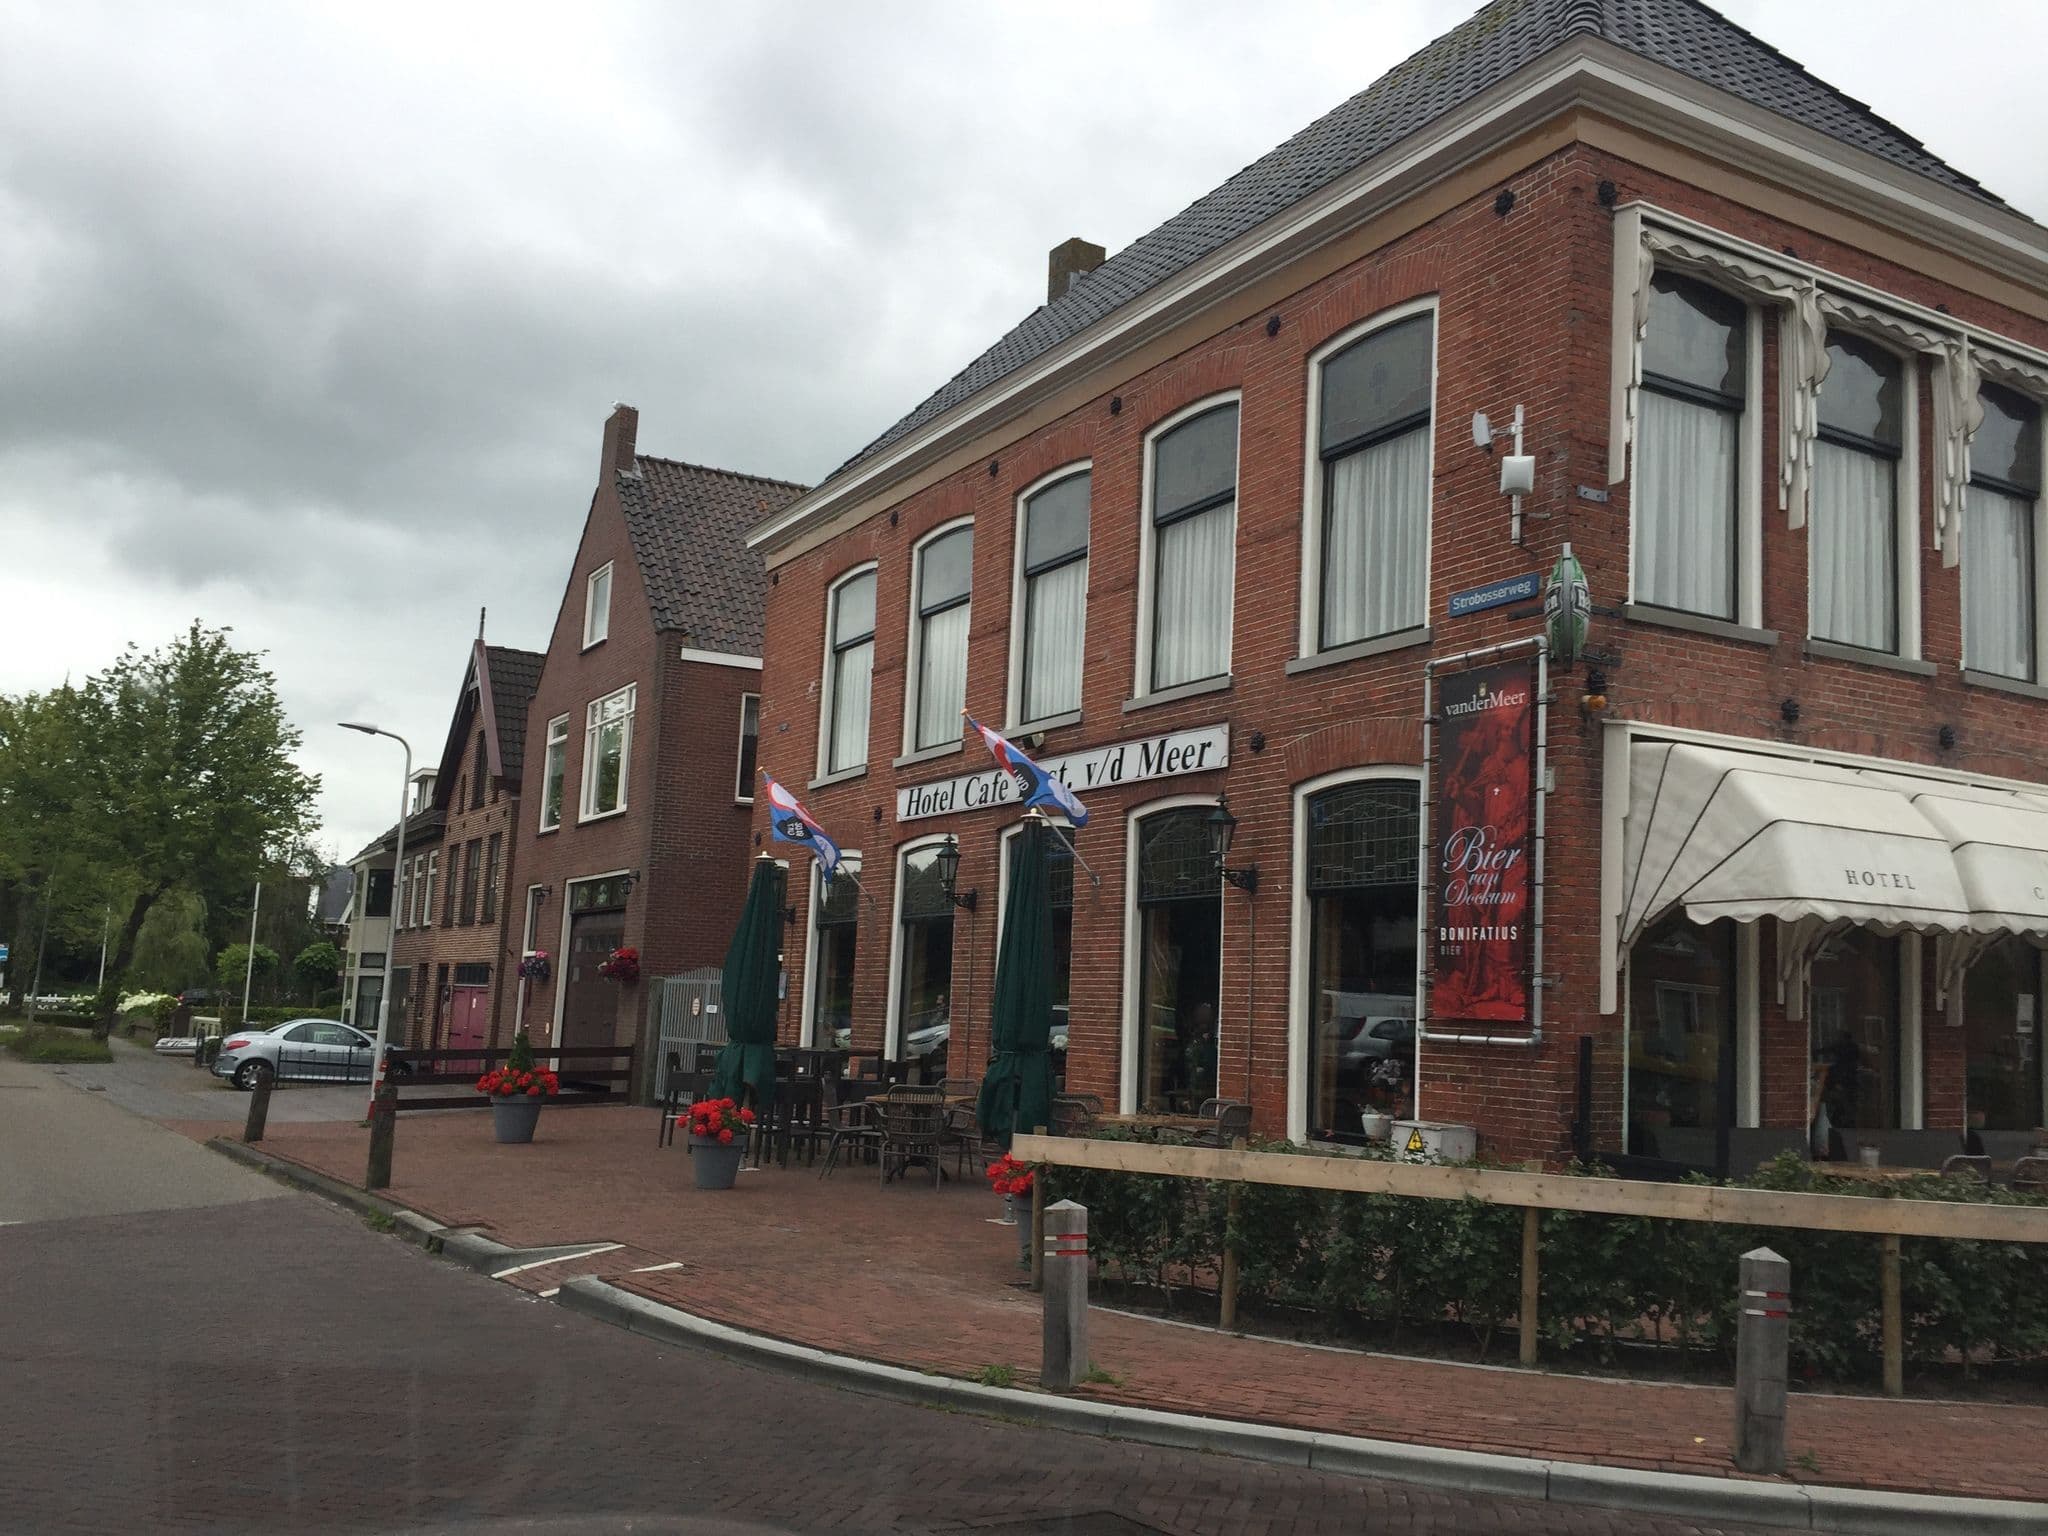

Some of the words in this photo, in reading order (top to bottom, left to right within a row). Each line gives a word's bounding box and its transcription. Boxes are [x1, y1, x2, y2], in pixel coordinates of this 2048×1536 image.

[1452, 580, 1531, 610] Strobosserweg
[1445, 690, 1526, 716] vanderMeer
[906, 780, 956, 817] Hotel
[964, 771, 1009, 807] Cafe
[1086, 747, 1125, 786] v/d
[1136, 738, 1212, 777] Meer
[1442, 825, 1521, 874] Bier
[1845, 870, 1916, 890] HOTEL
[1440, 926, 1518, 941] BONIFATIUS
